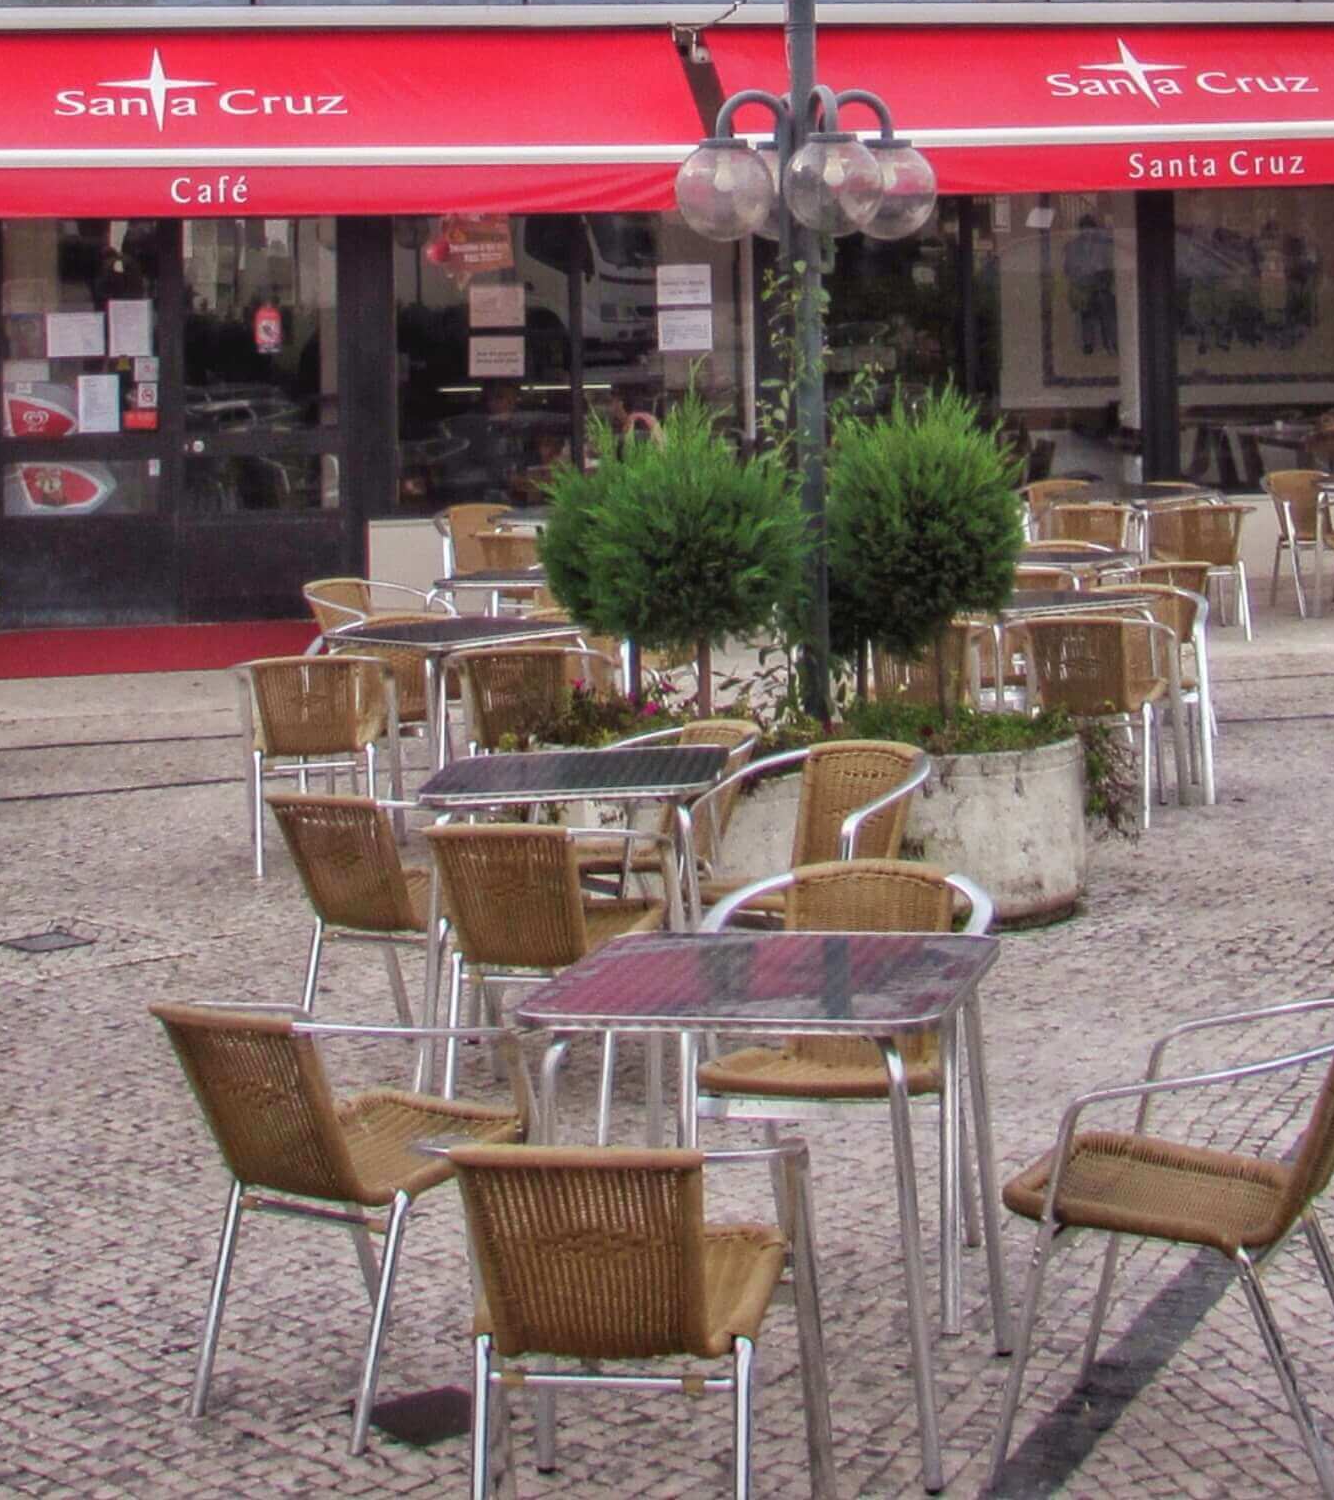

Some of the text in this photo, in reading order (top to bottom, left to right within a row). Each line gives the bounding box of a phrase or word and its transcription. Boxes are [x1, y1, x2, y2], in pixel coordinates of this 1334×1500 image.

[1045, 63, 1319, 107] Santa Cruz
[54, 80, 348, 131] Santa Cruz
[1128, 151, 1305, 178] Santa Cruz
[170, 175, 249, 204] Café
